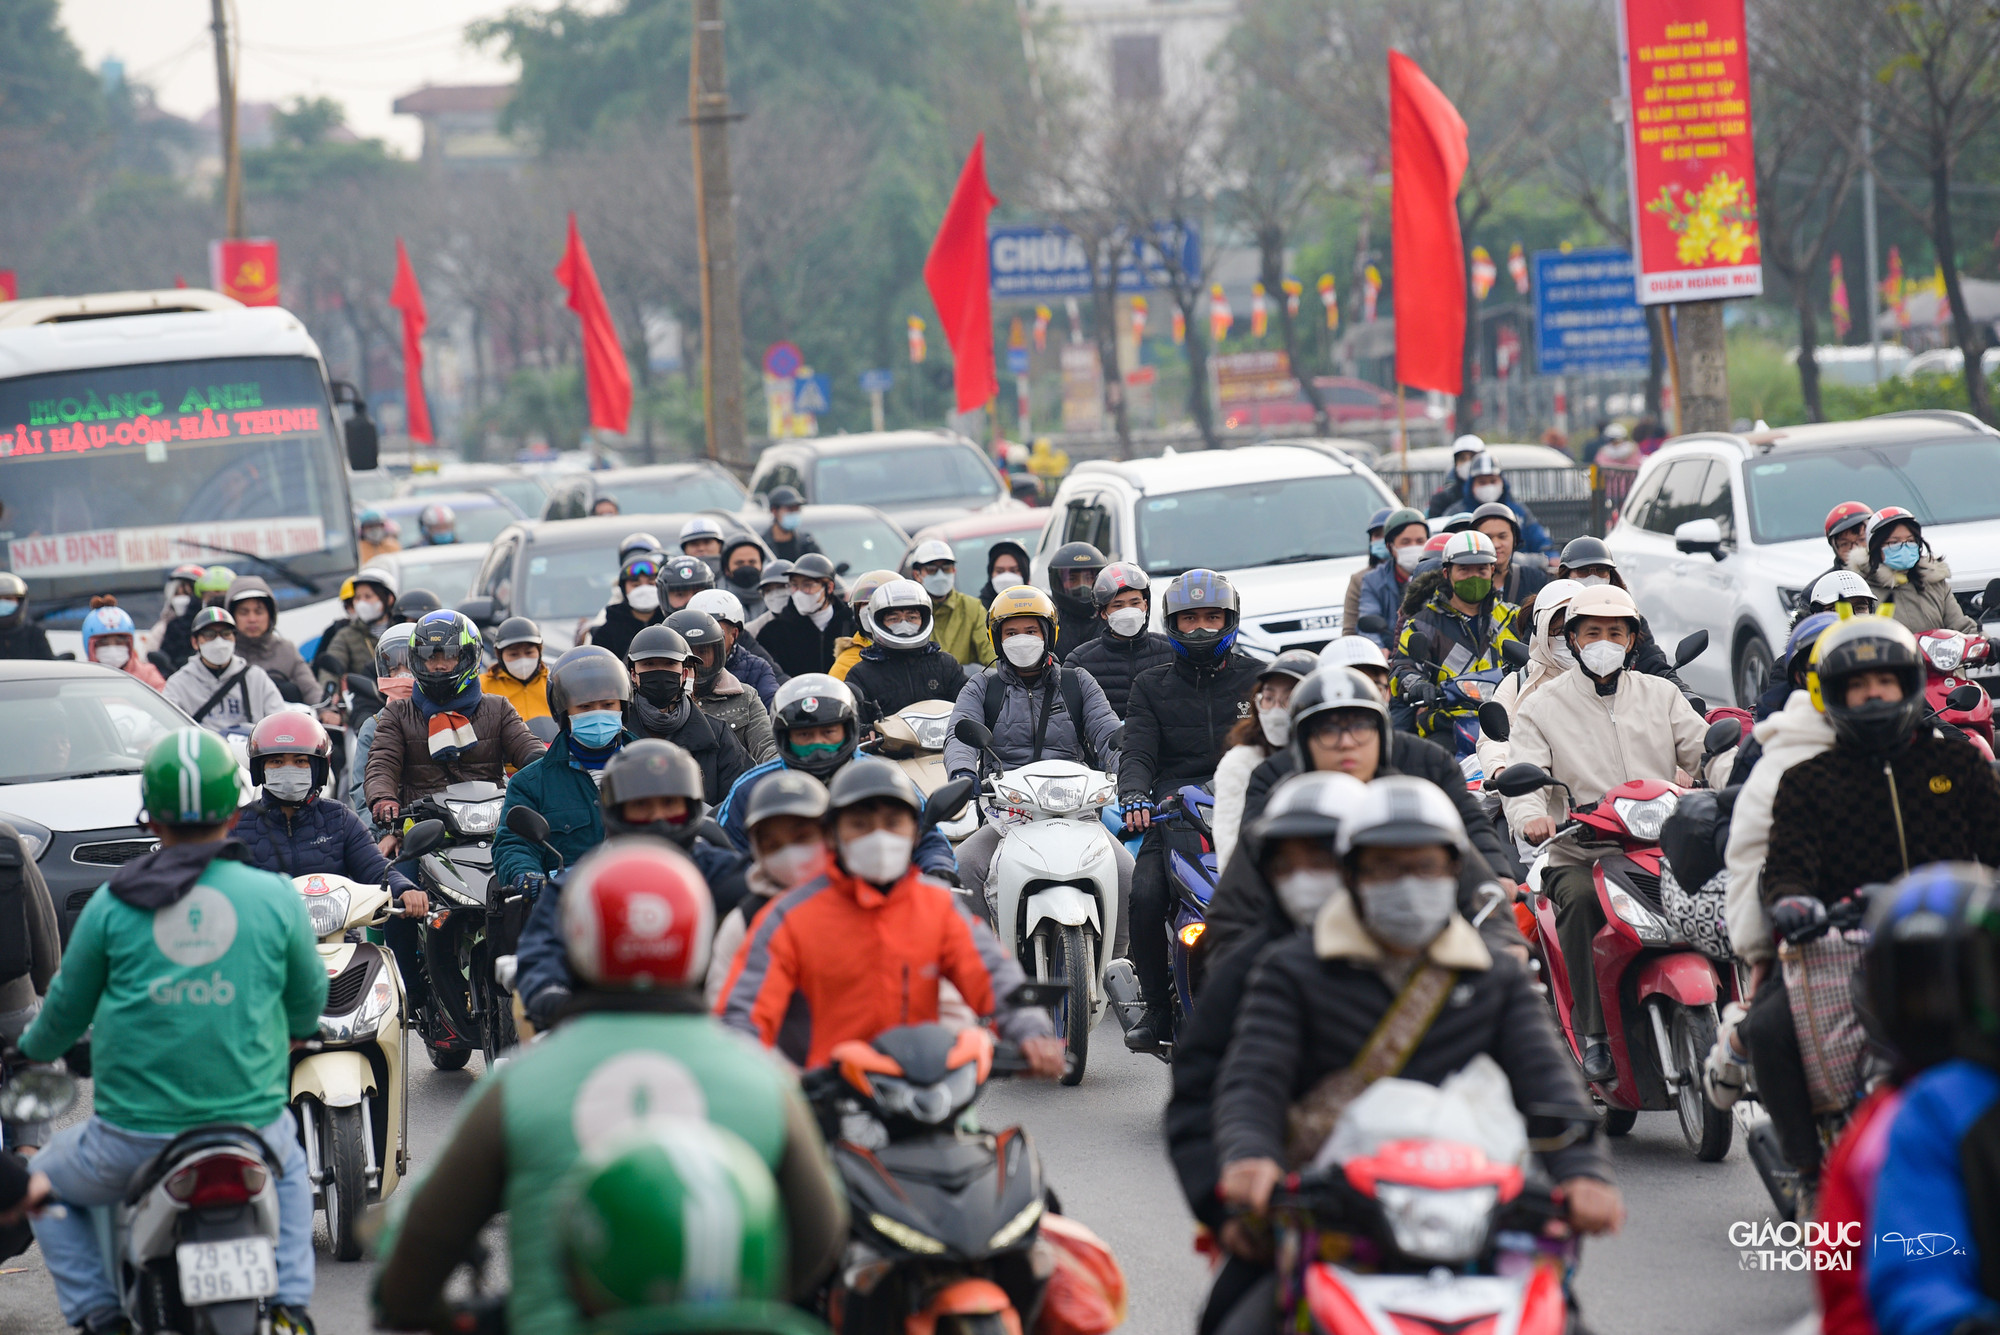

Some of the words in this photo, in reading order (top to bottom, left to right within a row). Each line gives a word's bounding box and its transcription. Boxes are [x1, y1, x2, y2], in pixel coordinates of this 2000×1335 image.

[29, 388, 164, 426] HOÀNG
[178, 382, 263, 413] ANH
[11, 537, 59, 569] NAM
[64, 532, 118, 566] ĐỊNH
[1300, 615, 1343, 630] ISUZ
[148, 970, 236, 1006] Grab
